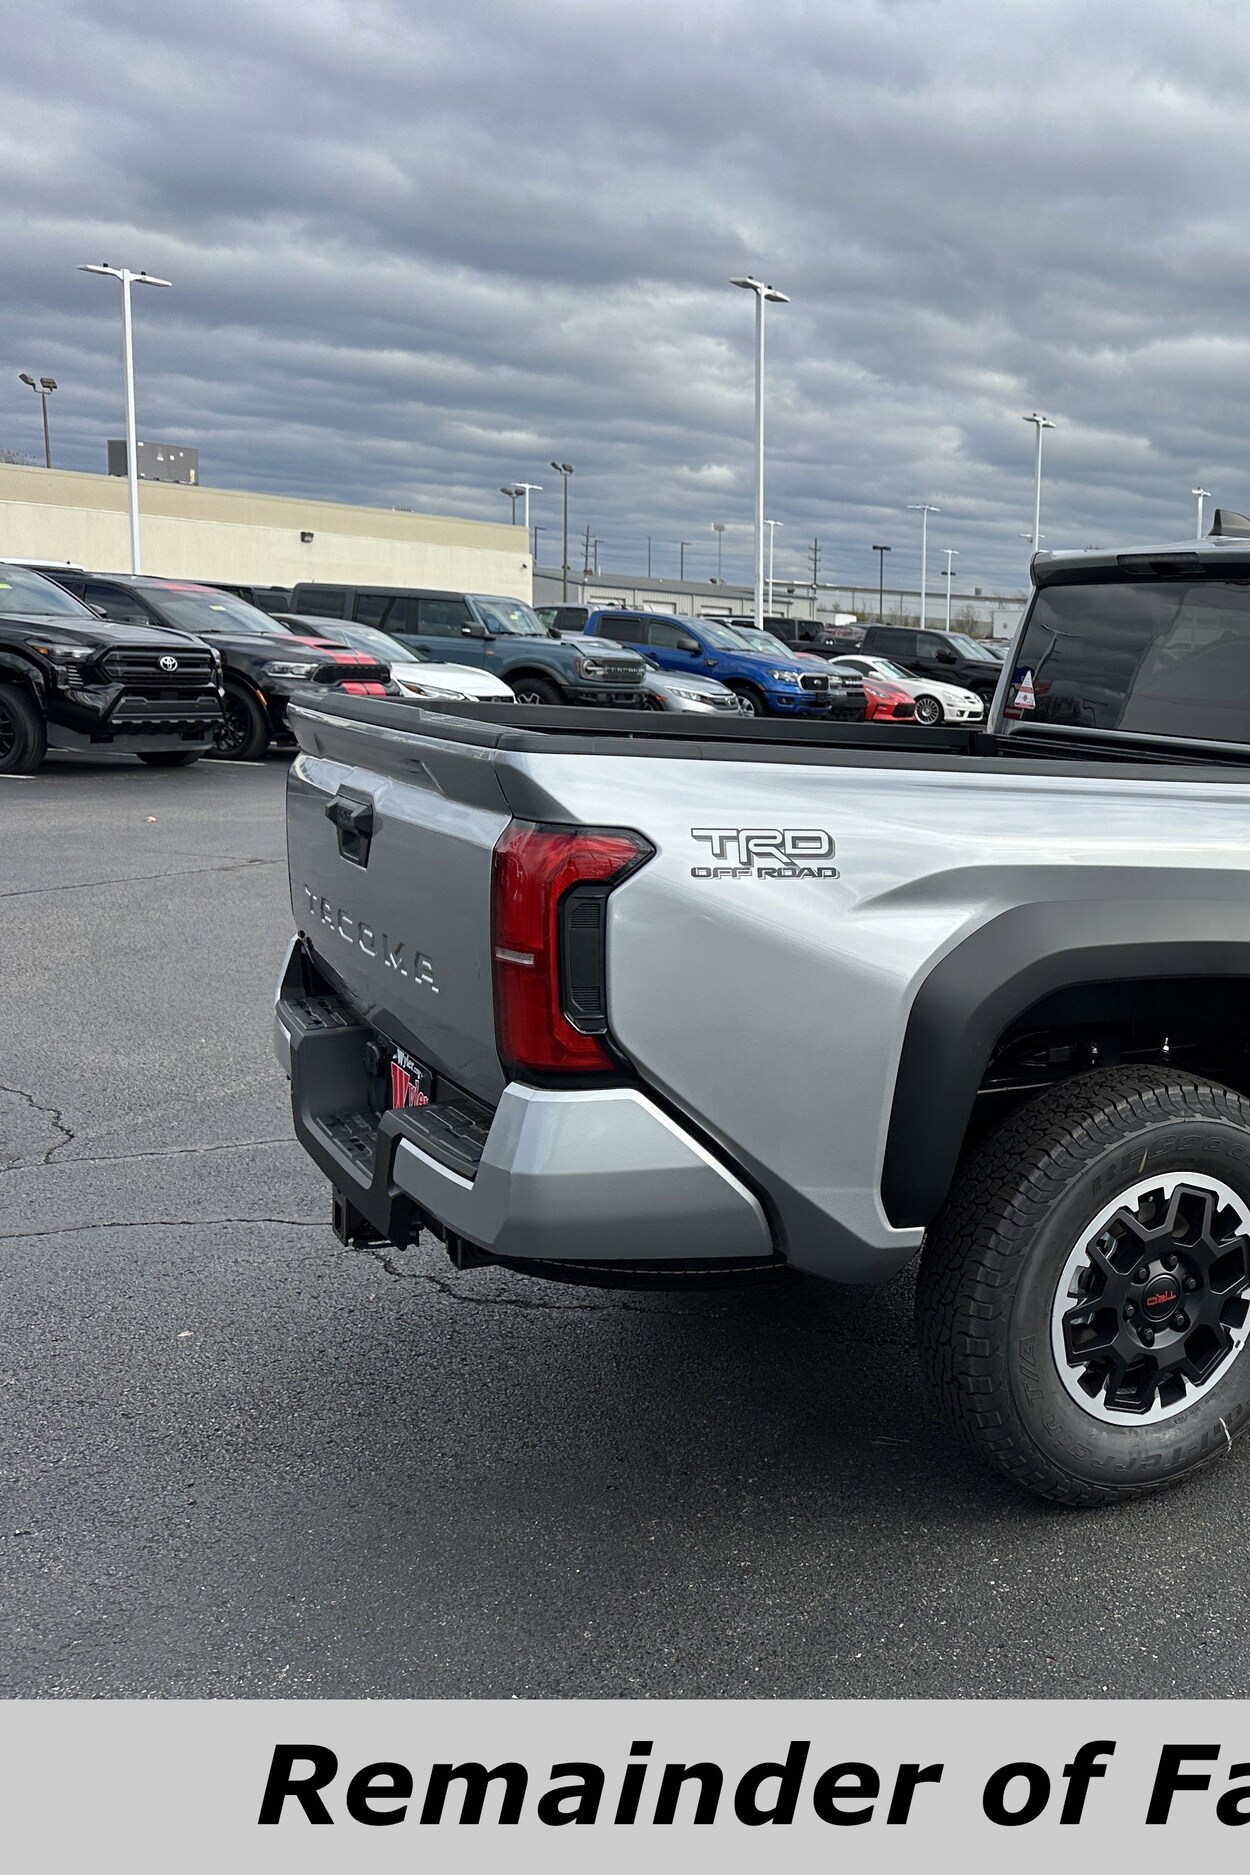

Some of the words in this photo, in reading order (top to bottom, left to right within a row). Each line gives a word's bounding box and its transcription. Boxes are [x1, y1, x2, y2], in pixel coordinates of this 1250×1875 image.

[690, 828, 836, 869] TRD
[690, 867, 753, 880] OFF
[757, 867, 840, 881] ROAD
[304, 883, 441, 994] TACOMA
[1146, 1290, 1177, 1306] TRD
